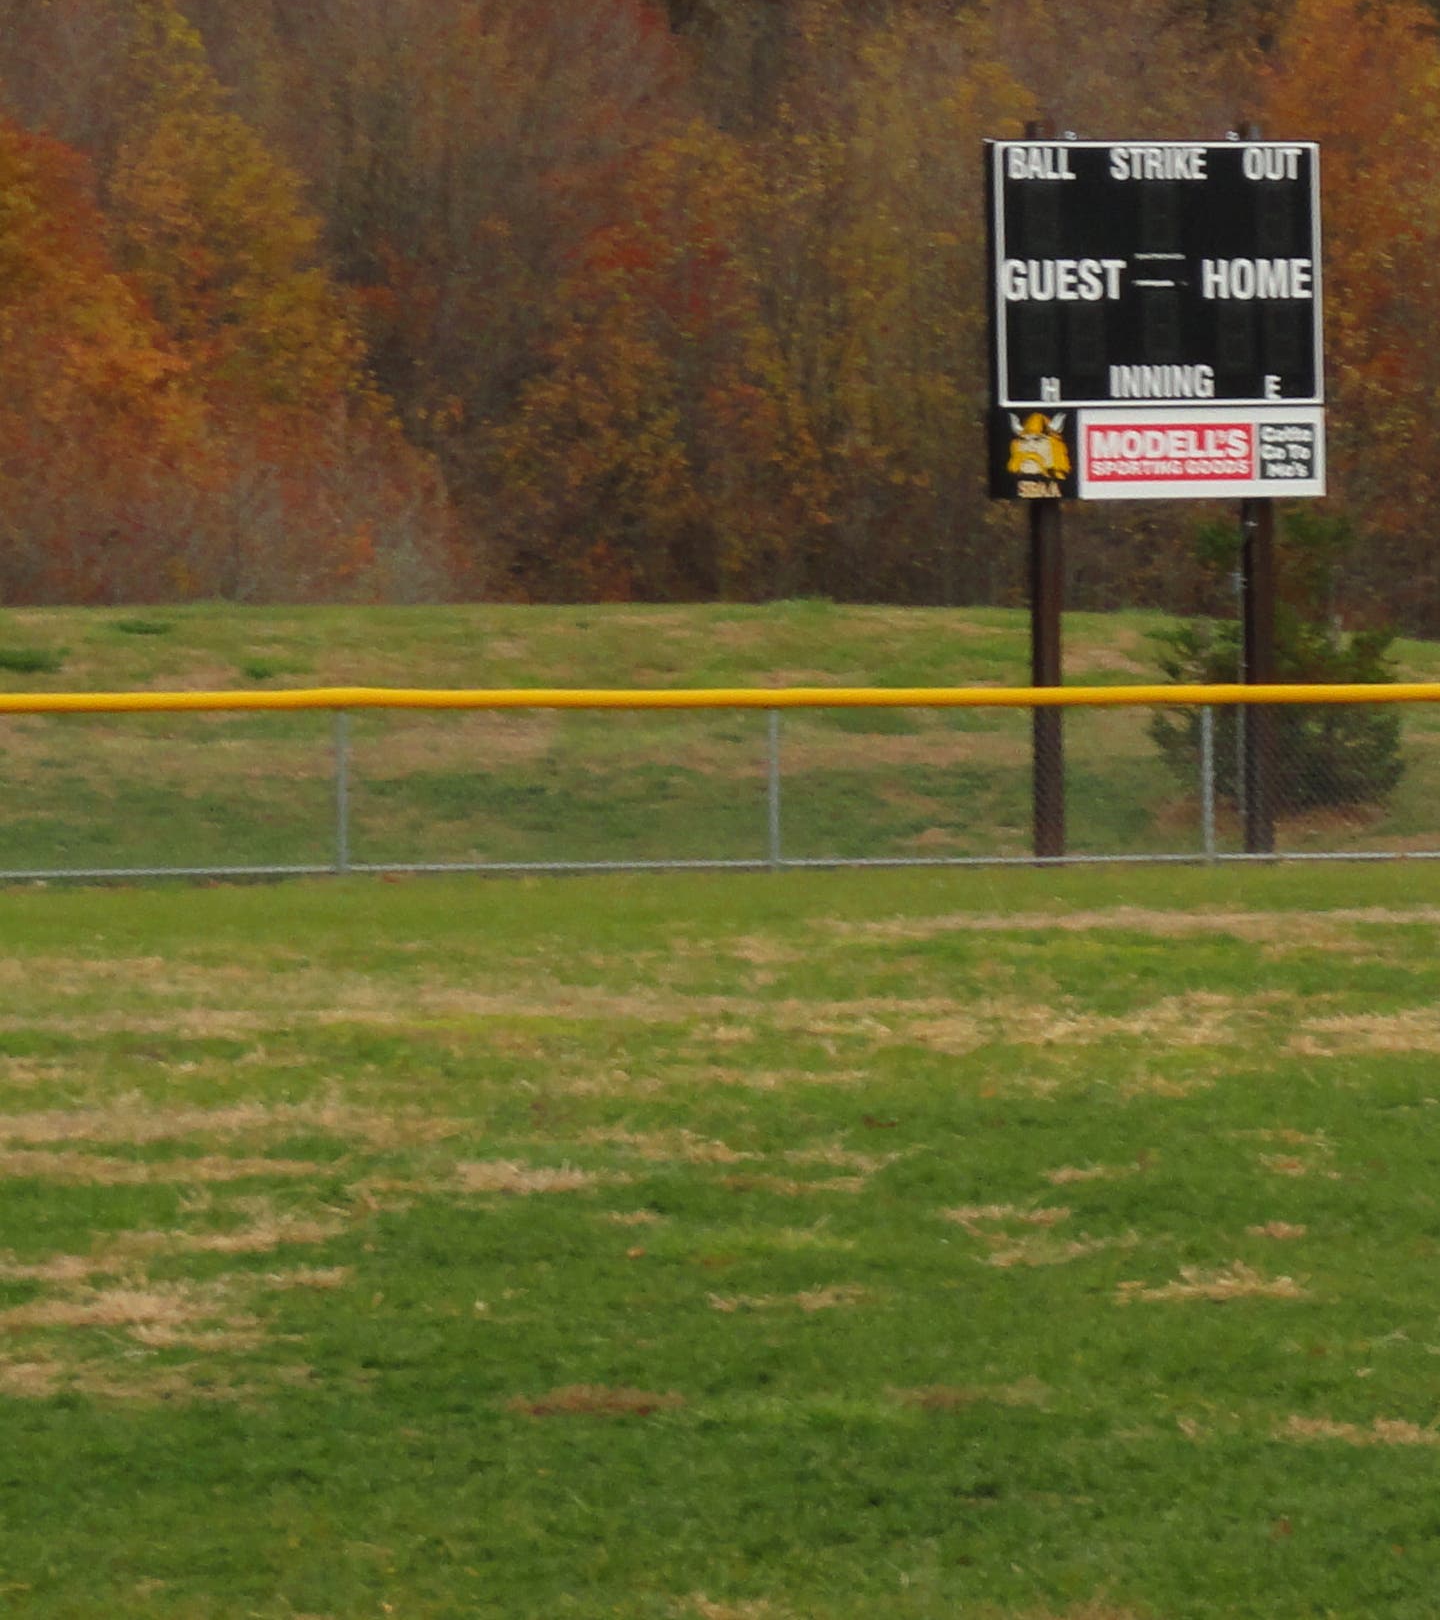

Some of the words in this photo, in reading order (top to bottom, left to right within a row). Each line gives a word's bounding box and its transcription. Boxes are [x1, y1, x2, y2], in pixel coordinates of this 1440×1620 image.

[1007, 147, 1076, 180] BALL
[1109, 147, 1207, 180] STRIKE
[1243, 147, 1302, 180] OUT
[1003, 258, 1127, 301] GUEST
[1202, 258, 1312, 300] HOME
[1040, 377, 1061, 401] H
[1109, 364, 1215, 398] INNING
[1264, 375, 1282, 400] E
[1090, 430, 1249, 459] MODELL'S
